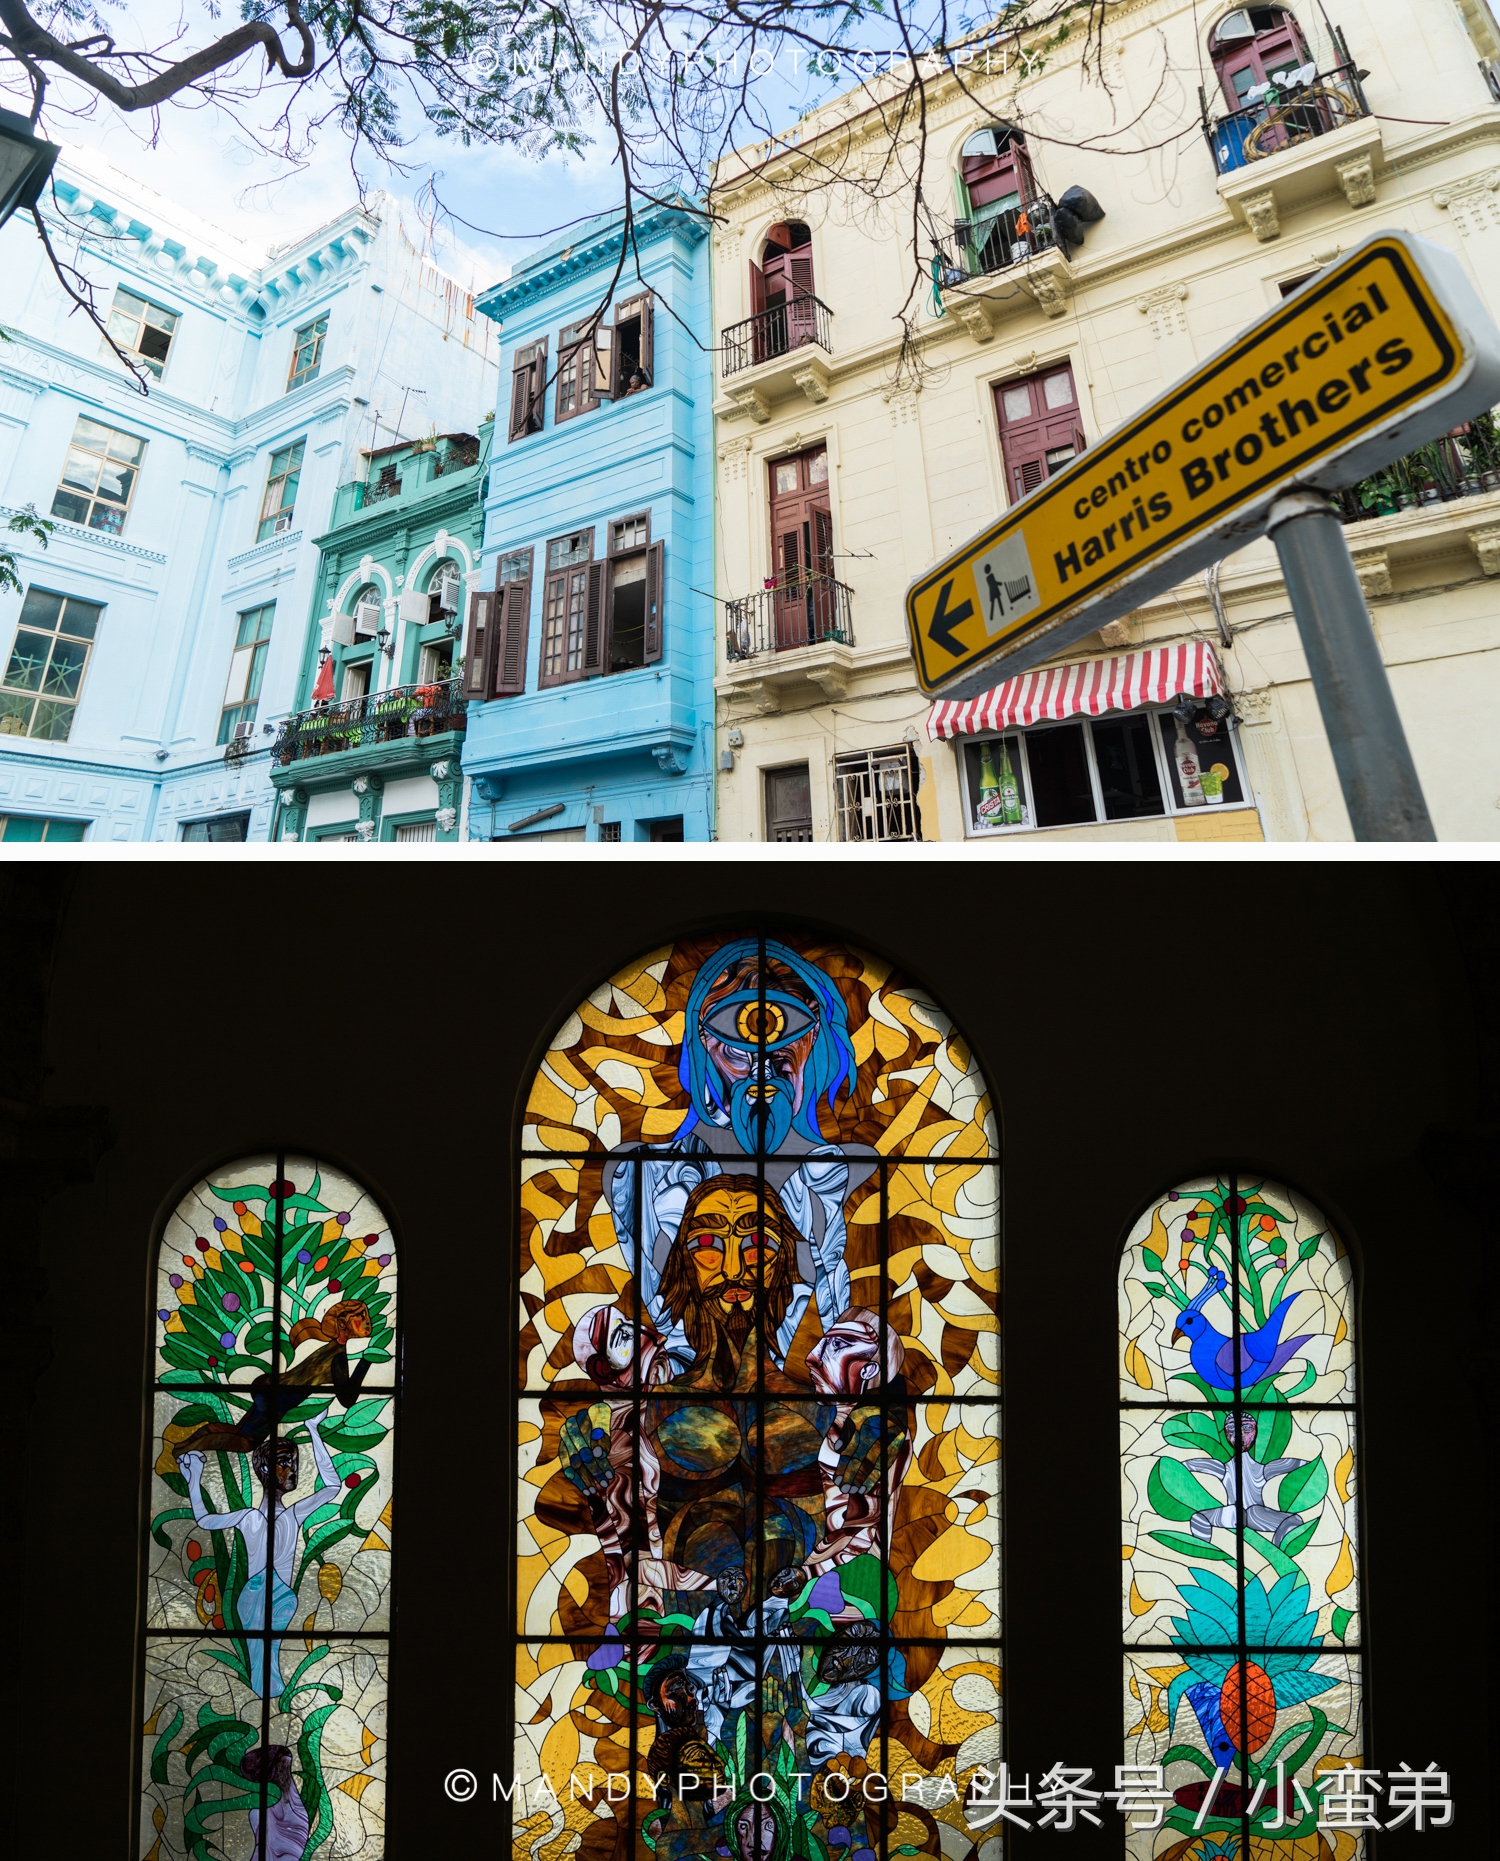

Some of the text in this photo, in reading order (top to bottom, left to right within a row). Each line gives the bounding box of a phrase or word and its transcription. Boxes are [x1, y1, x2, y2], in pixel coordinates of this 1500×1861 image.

[1054, 337, 1413, 583] Harris Brothers
[1075, 283, 1388, 520] centro comercial
[981, 796, 1001, 814] CRISTA
